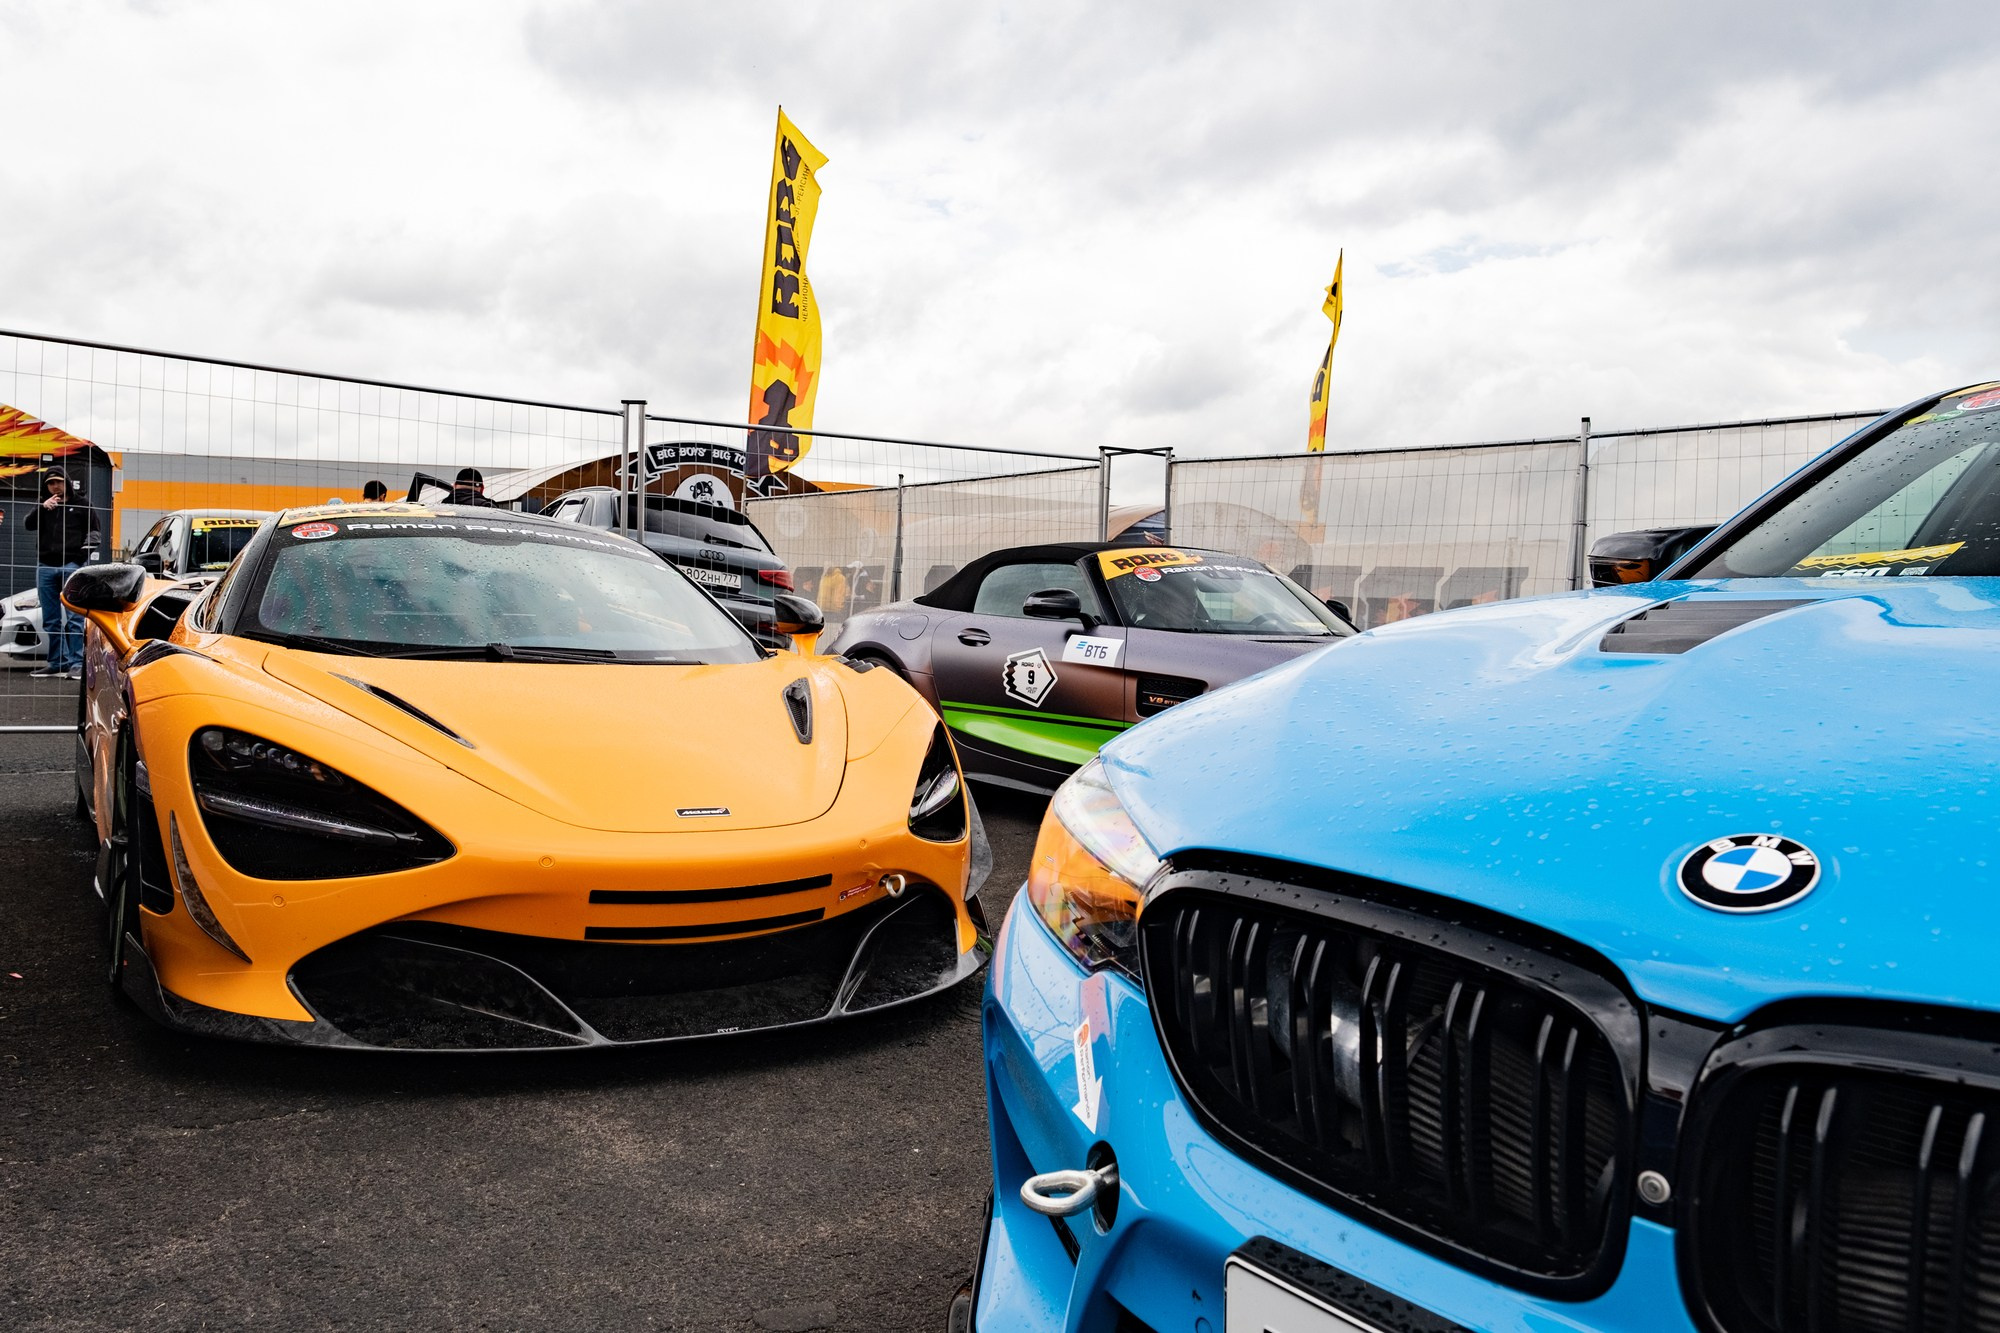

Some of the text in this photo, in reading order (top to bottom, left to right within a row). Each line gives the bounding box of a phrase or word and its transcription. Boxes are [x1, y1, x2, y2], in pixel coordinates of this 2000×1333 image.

[656, 448, 676, 460] BIG
[712, 448, 732, 461] BIG
[733, 452, 746, 466] TO
[346, 523, 457, 531] Ramon
[1111, 553, 1180, 570] RDRC
[1160, 565, 1213, 575] Ramon
[1085, 645, 1108, 659] ВТБ
[1027, 669, 1036, 686] 9
[1709, 835, 1815, 866] BMW
